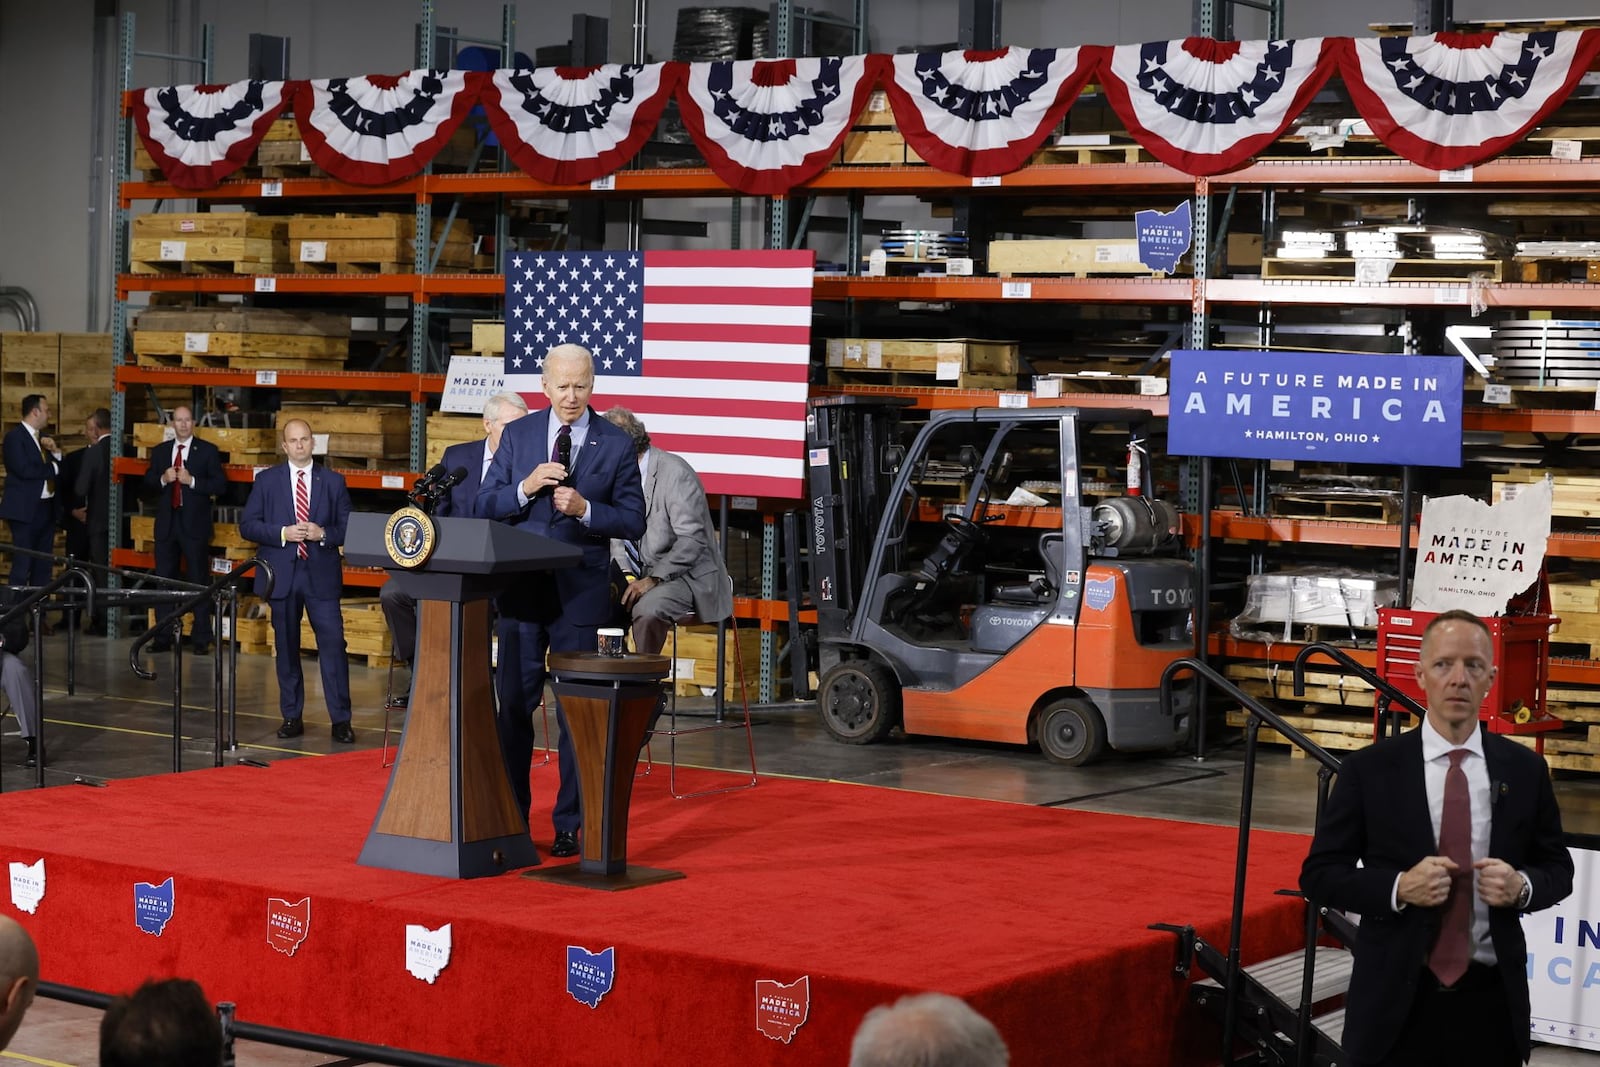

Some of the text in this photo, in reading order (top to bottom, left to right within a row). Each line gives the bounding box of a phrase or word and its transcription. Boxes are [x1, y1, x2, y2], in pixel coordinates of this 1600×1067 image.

[1141, 236, 1184, 244] AMERICA
[454, 378, 487, 386] MADE
[1195, 371, 1437, 391] A FUTURE MADE IN
[1184, 392, 1446, 423] AMERICA
[1256, 430, 1368, 443] HAMILTON, OHIO
[814, 496, 825, 555] TOYOTA
[1464, 528, 1509, 537] FUTURE
[1432, 535, 1525, 555] MADE IN
[1424, 551, 1524, 572] AMERICA
[1439, 587, 1475, 596] HAMILTON,
[1002, 618, 1033, 626] TOYOTA
[138, 904, 168, 913] AMERICA
[272, 913, 291, 924] MADE
[271, 920, 302, 934] AMERICA
[1554, 916, 1600, 950] IN
[411, 940, 431, 950] MADE
[572, 962, 593, 974] MADE
[570, 968, 605, 985] AMERICA
[762, 997, 786, 1007] MADE
[760, 1004, 800, 1017] AMERICA
